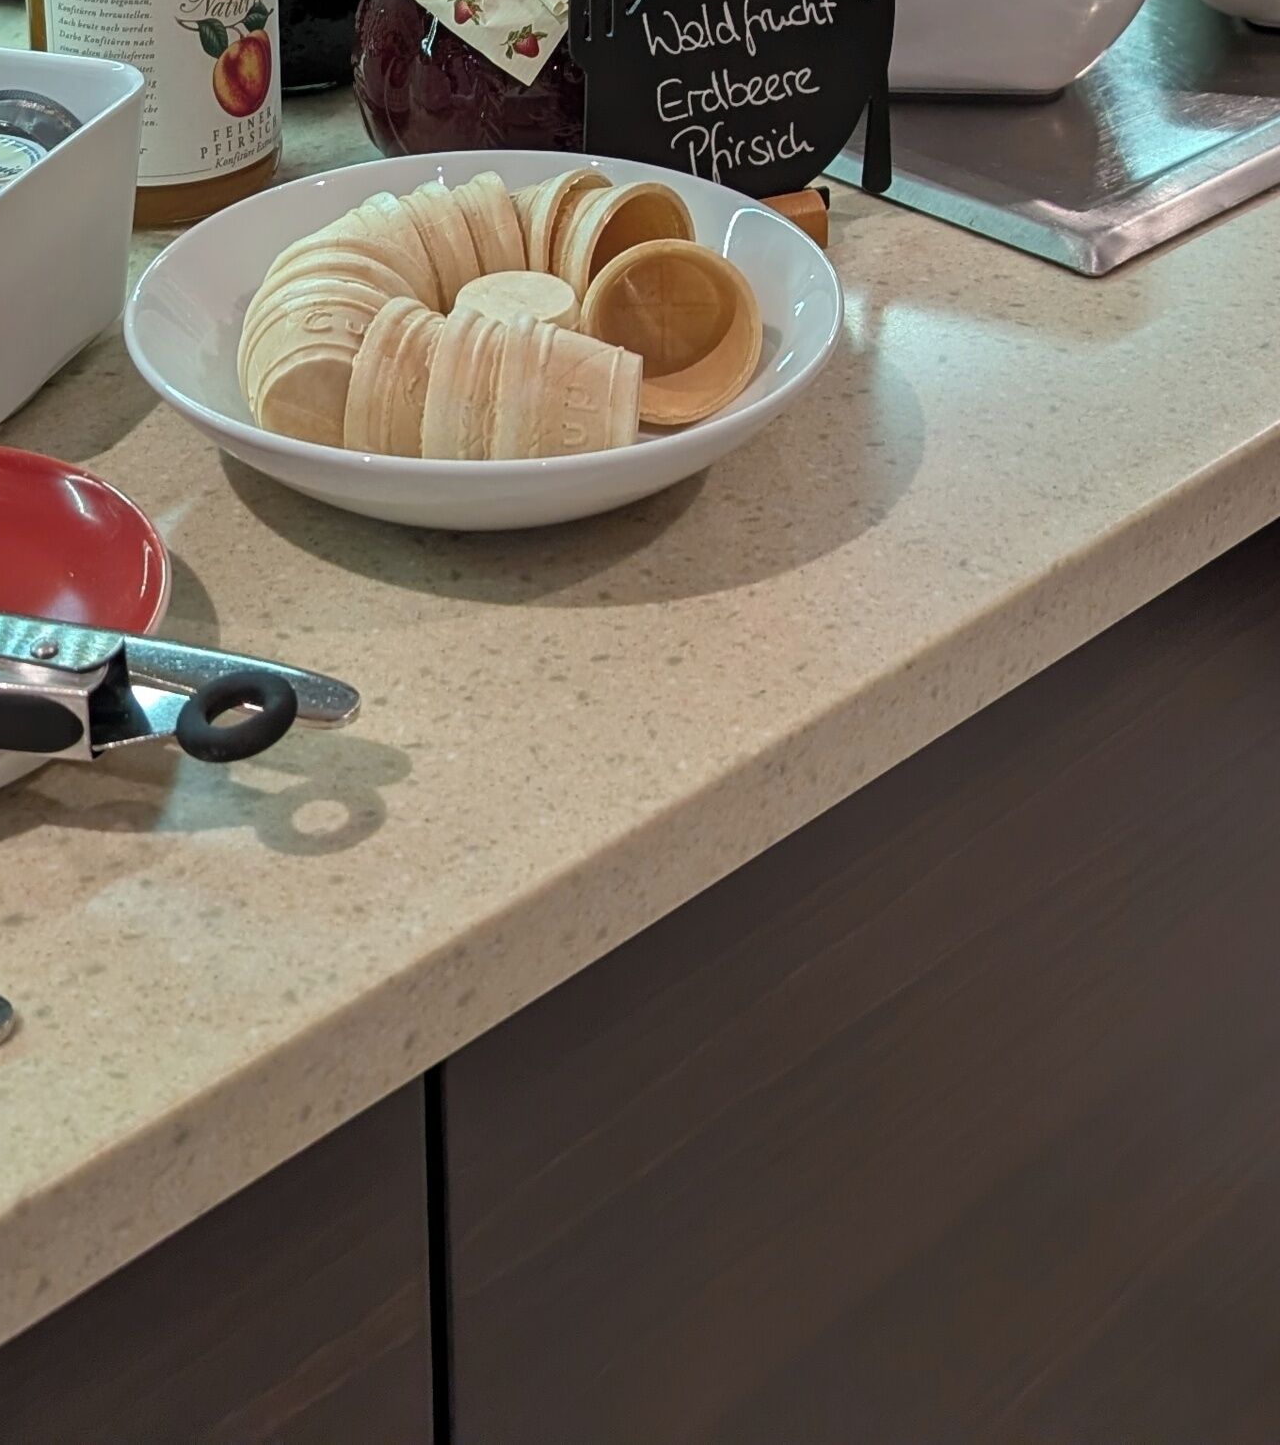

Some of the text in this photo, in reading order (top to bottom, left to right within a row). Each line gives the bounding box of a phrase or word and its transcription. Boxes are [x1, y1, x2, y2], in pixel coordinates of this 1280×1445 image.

[58, 3, 152, 19] Konfitüren herzustellen.
[58, 17, 154, 33] Auch heute noch werden
[59, 29, 155, 47] Darbo Konfitüren nach
[657, 66, 820, 122] Erdbeere
[212, 106, 272, 142] FEINER
[215, 148, 255, 169] Konfitüre
[671, 122, 815, 184] Pfirsich
